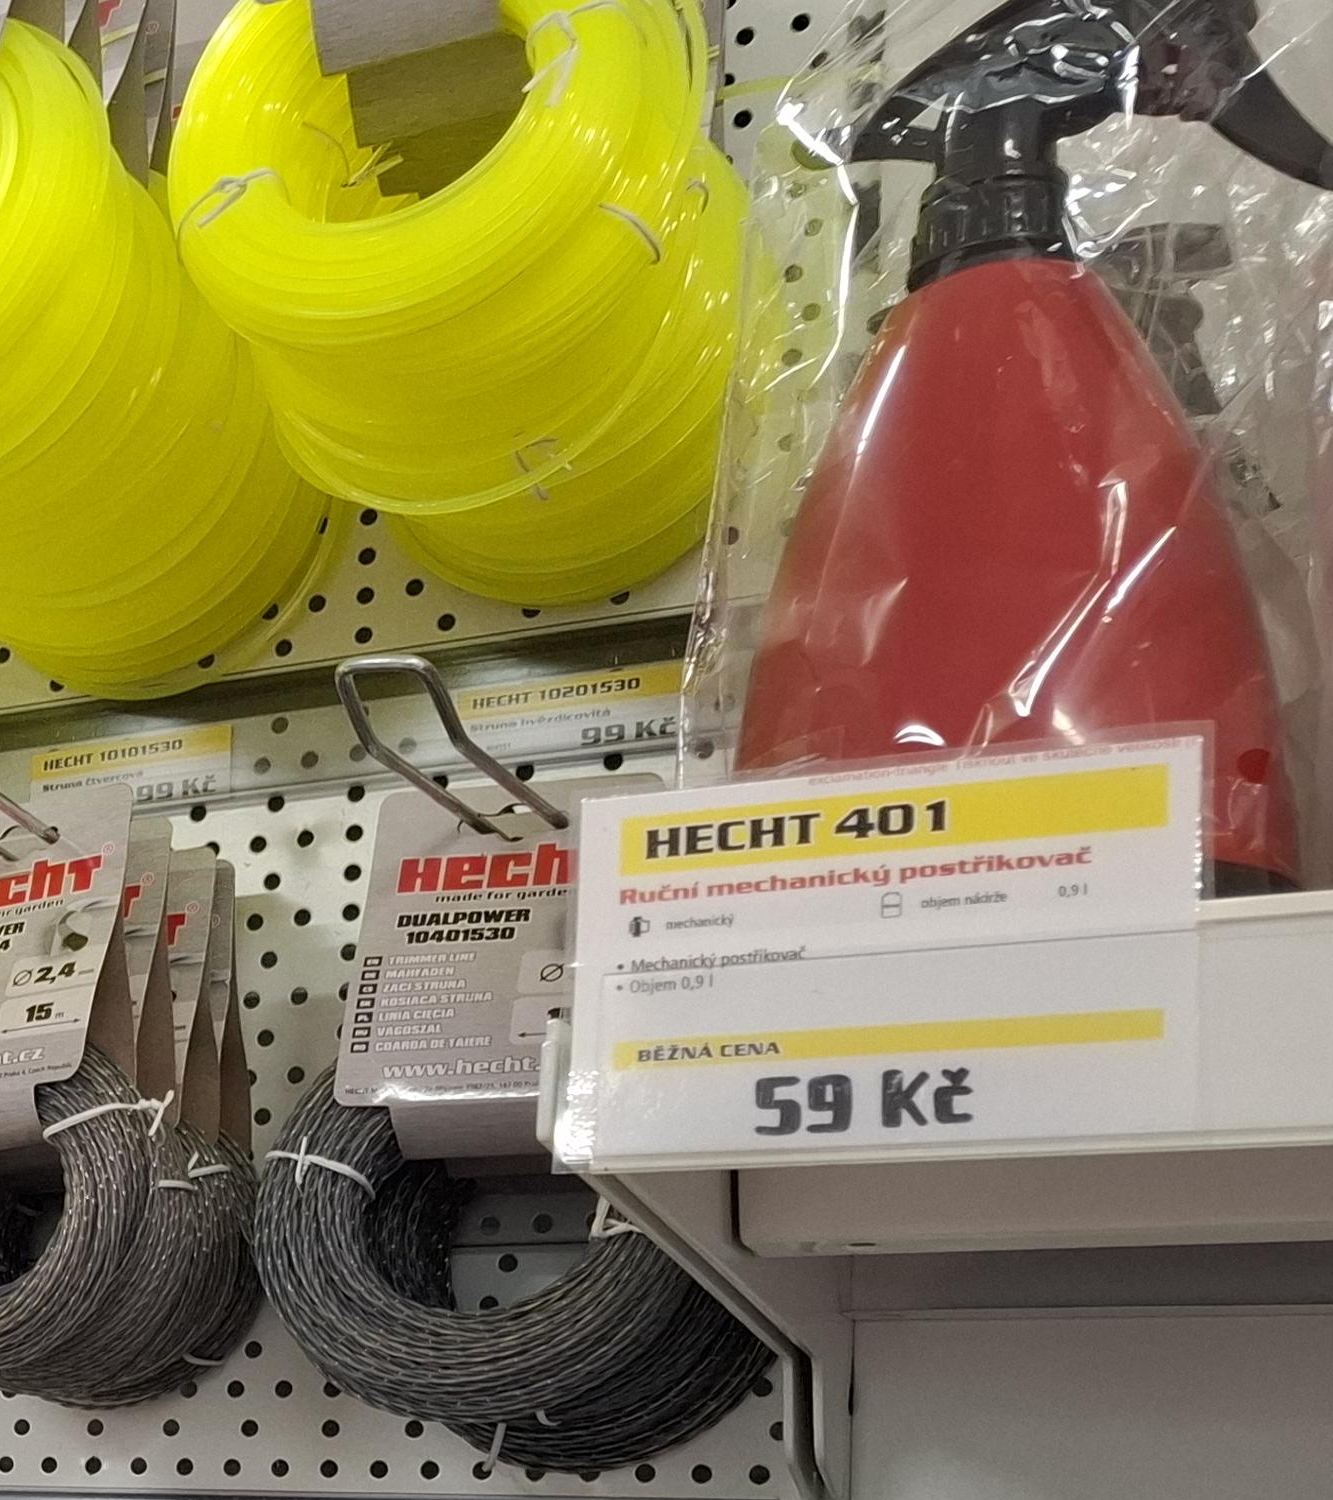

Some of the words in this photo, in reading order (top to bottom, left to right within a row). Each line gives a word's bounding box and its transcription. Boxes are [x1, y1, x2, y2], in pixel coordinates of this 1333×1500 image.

[472, 691, 532, 710] HECHT
[539, 677, 641, 703] 10201530
[581, 723, 626, 746] 99
[635, 716, 677, 739] Kč
[42, 752, 97, 773] HECHT
[99, 739, 183, 763] 10101530
[645, 811, 823, 862] HECHT
[833, 799, 948, 840] 401
[618, 881, 701, 907] Ruční
[706, 862, 891, 901] mechanický
[898, 845, 1094, 886] postřikovač
[397, 908, 531, 929] DUALPOWER
[665, 912, 734, 932] mechanický
[406, 926, 516, 944] 10401530
[629, 954, 717, 974] Mechanický
[719, 945, 807, 967] postřikovač
[629, 976, 677, 995] Objem
[636, 1041, 714, 1064] BĚŽNÁ
[718, 1040, 781, 1059] CENA
[754, 1072, 853, 1137] 59
[881, 1067, 975, 1130] Kč
